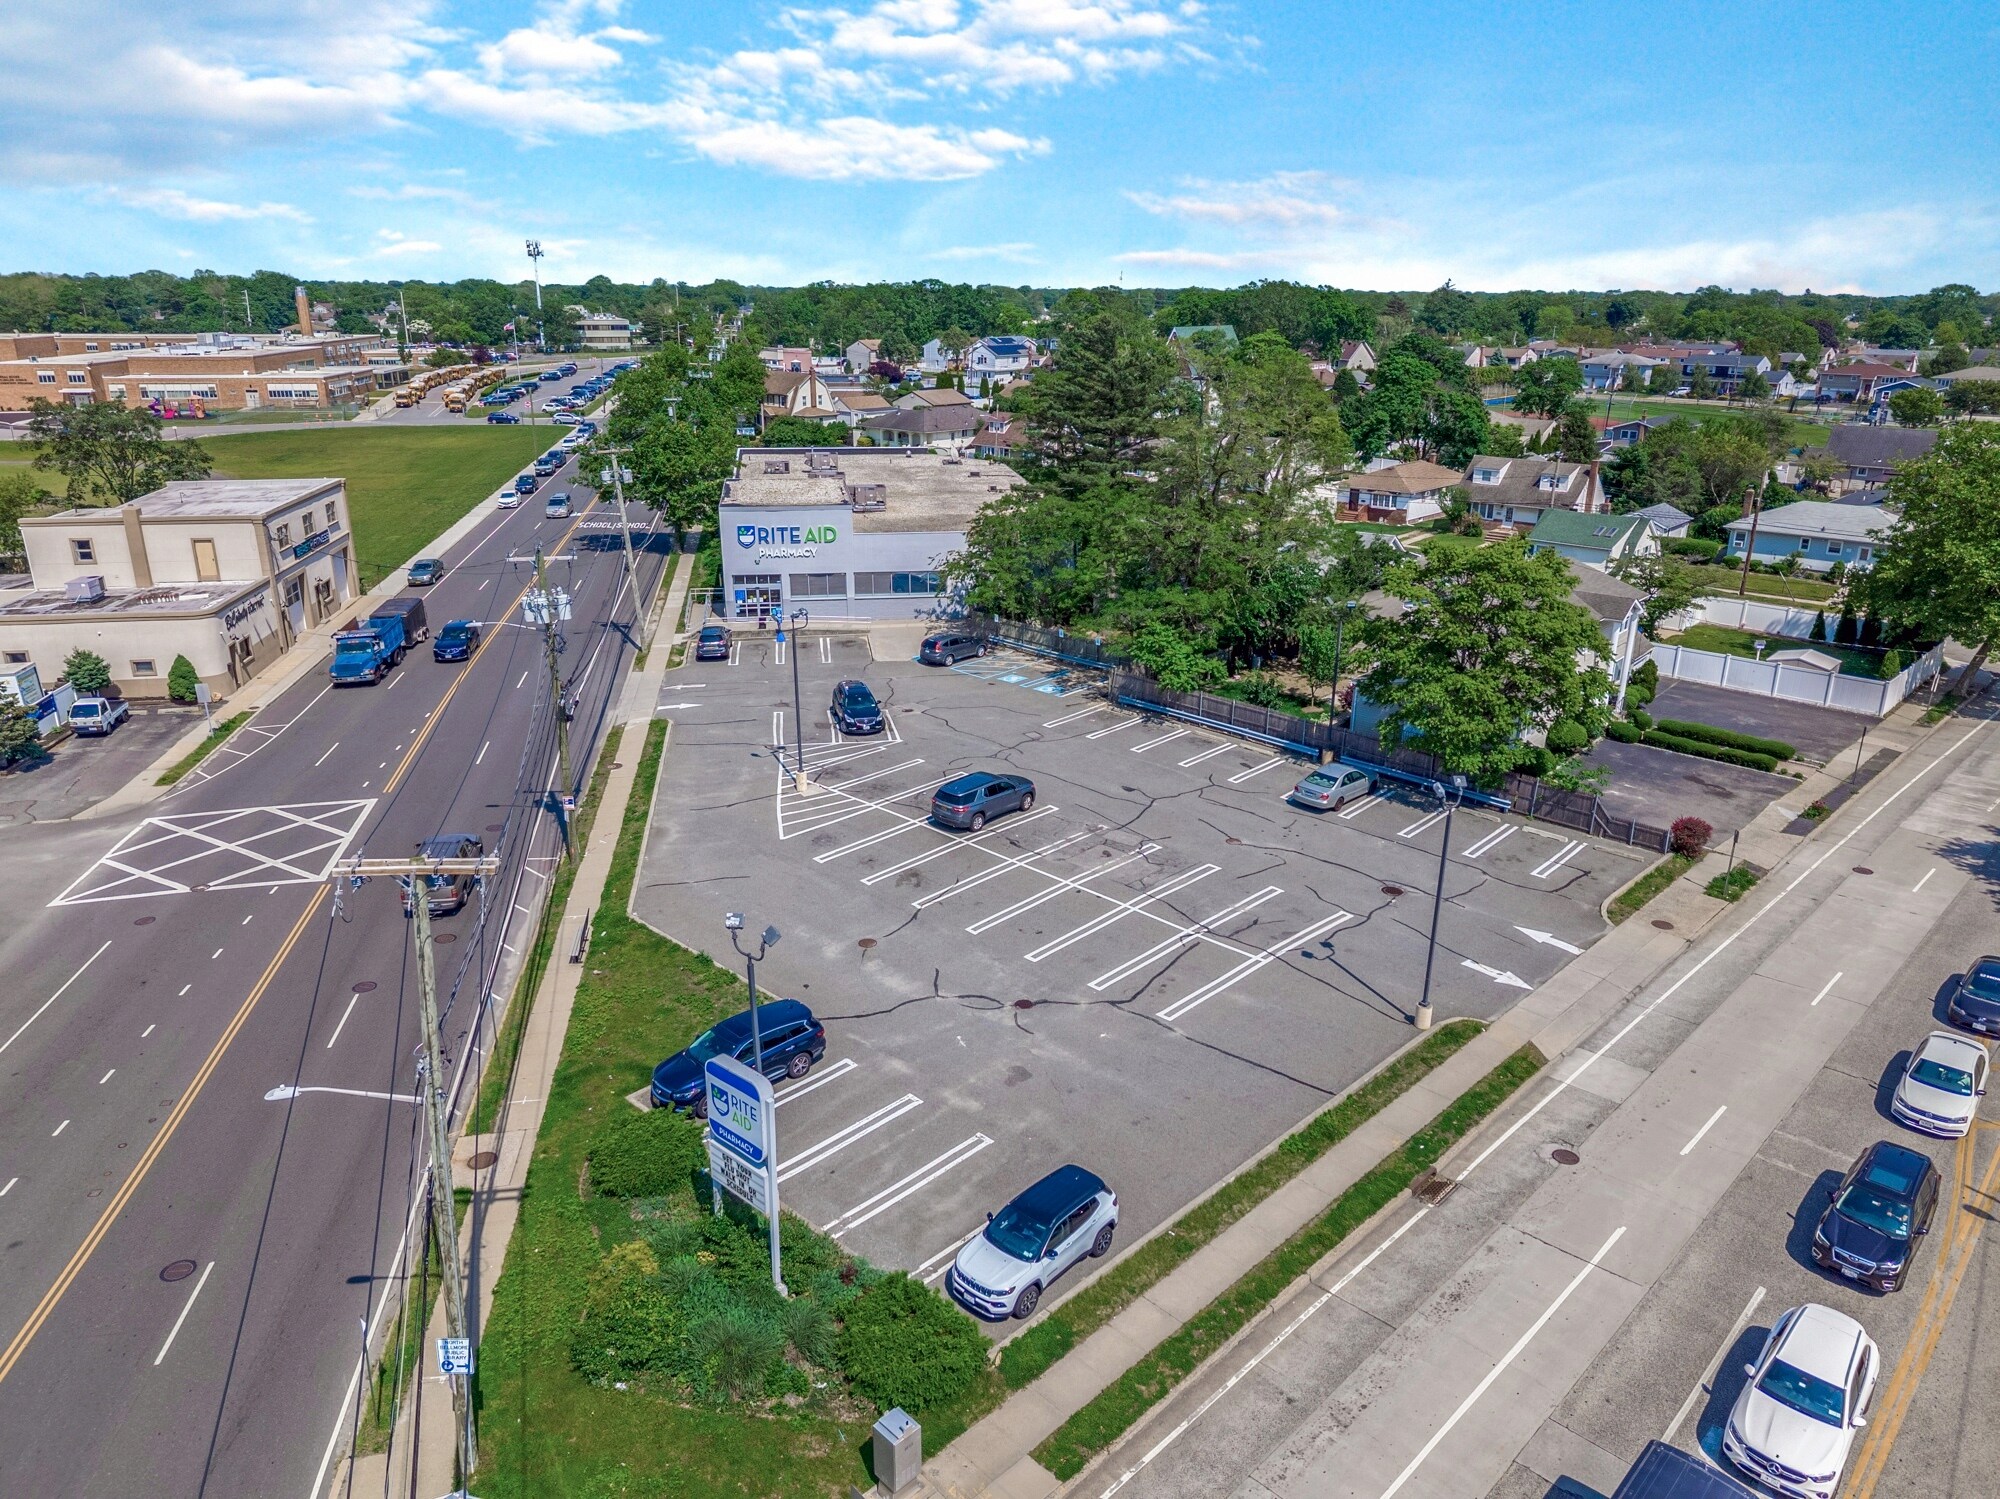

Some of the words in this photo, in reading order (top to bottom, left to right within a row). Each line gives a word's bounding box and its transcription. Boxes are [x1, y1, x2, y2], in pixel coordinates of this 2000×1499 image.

[578, 521, 612, 529] SCHOOL
[758, 526, 801, 545] RITE
[804, 525, 838, 544] AID
[759, 547, 818, 559] PHARMACY
[731, 1094, 757, 1122] RITE
[732, 1112, 752, 1132] AID
[719, 1127, 754, 1154] PHARMACY
[722, 1152, 733, 1165] GET
[736, 1161, 752, 1179] YOUR
[724, 1161, 735, 1174] FLU
[736, 1169, 750, 1184] SHOT
[720, 1167, 736, 1182] WALK
[739, 1179, 745, 1190] IN
[748, 1186, 757, 1198] OR
[726, 1178, 753, 1203] SCHEDULE
